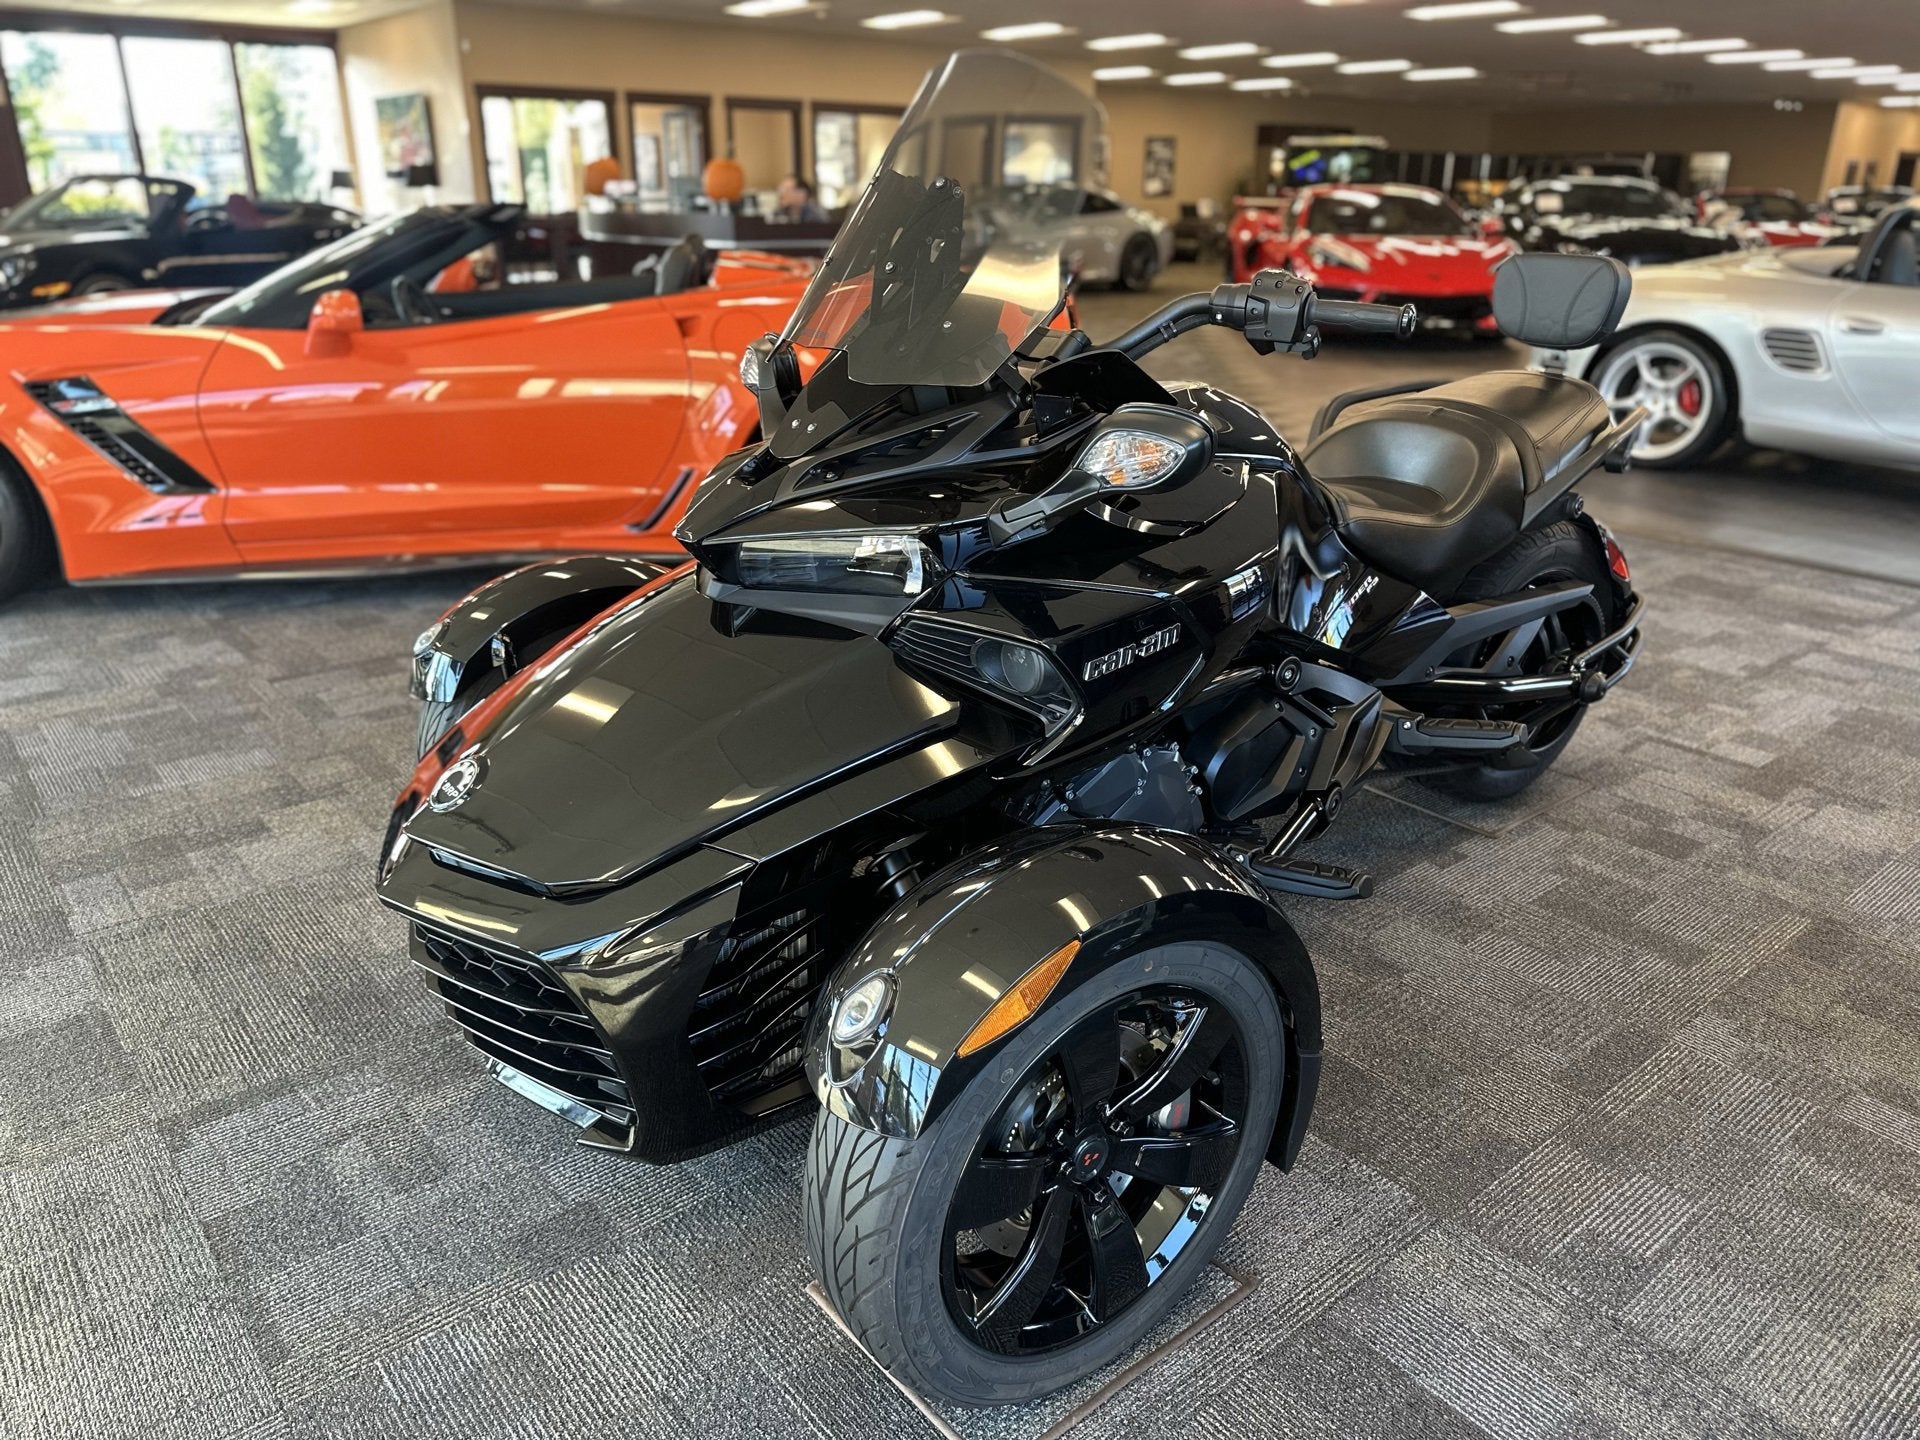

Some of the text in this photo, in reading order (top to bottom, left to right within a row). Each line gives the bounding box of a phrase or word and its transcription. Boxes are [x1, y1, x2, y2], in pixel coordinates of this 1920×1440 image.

[1083, 622, 1181, 681] can-am
[441, 781, 460, 798] BRP
[906, 1221, 945, 1369] KENDA
